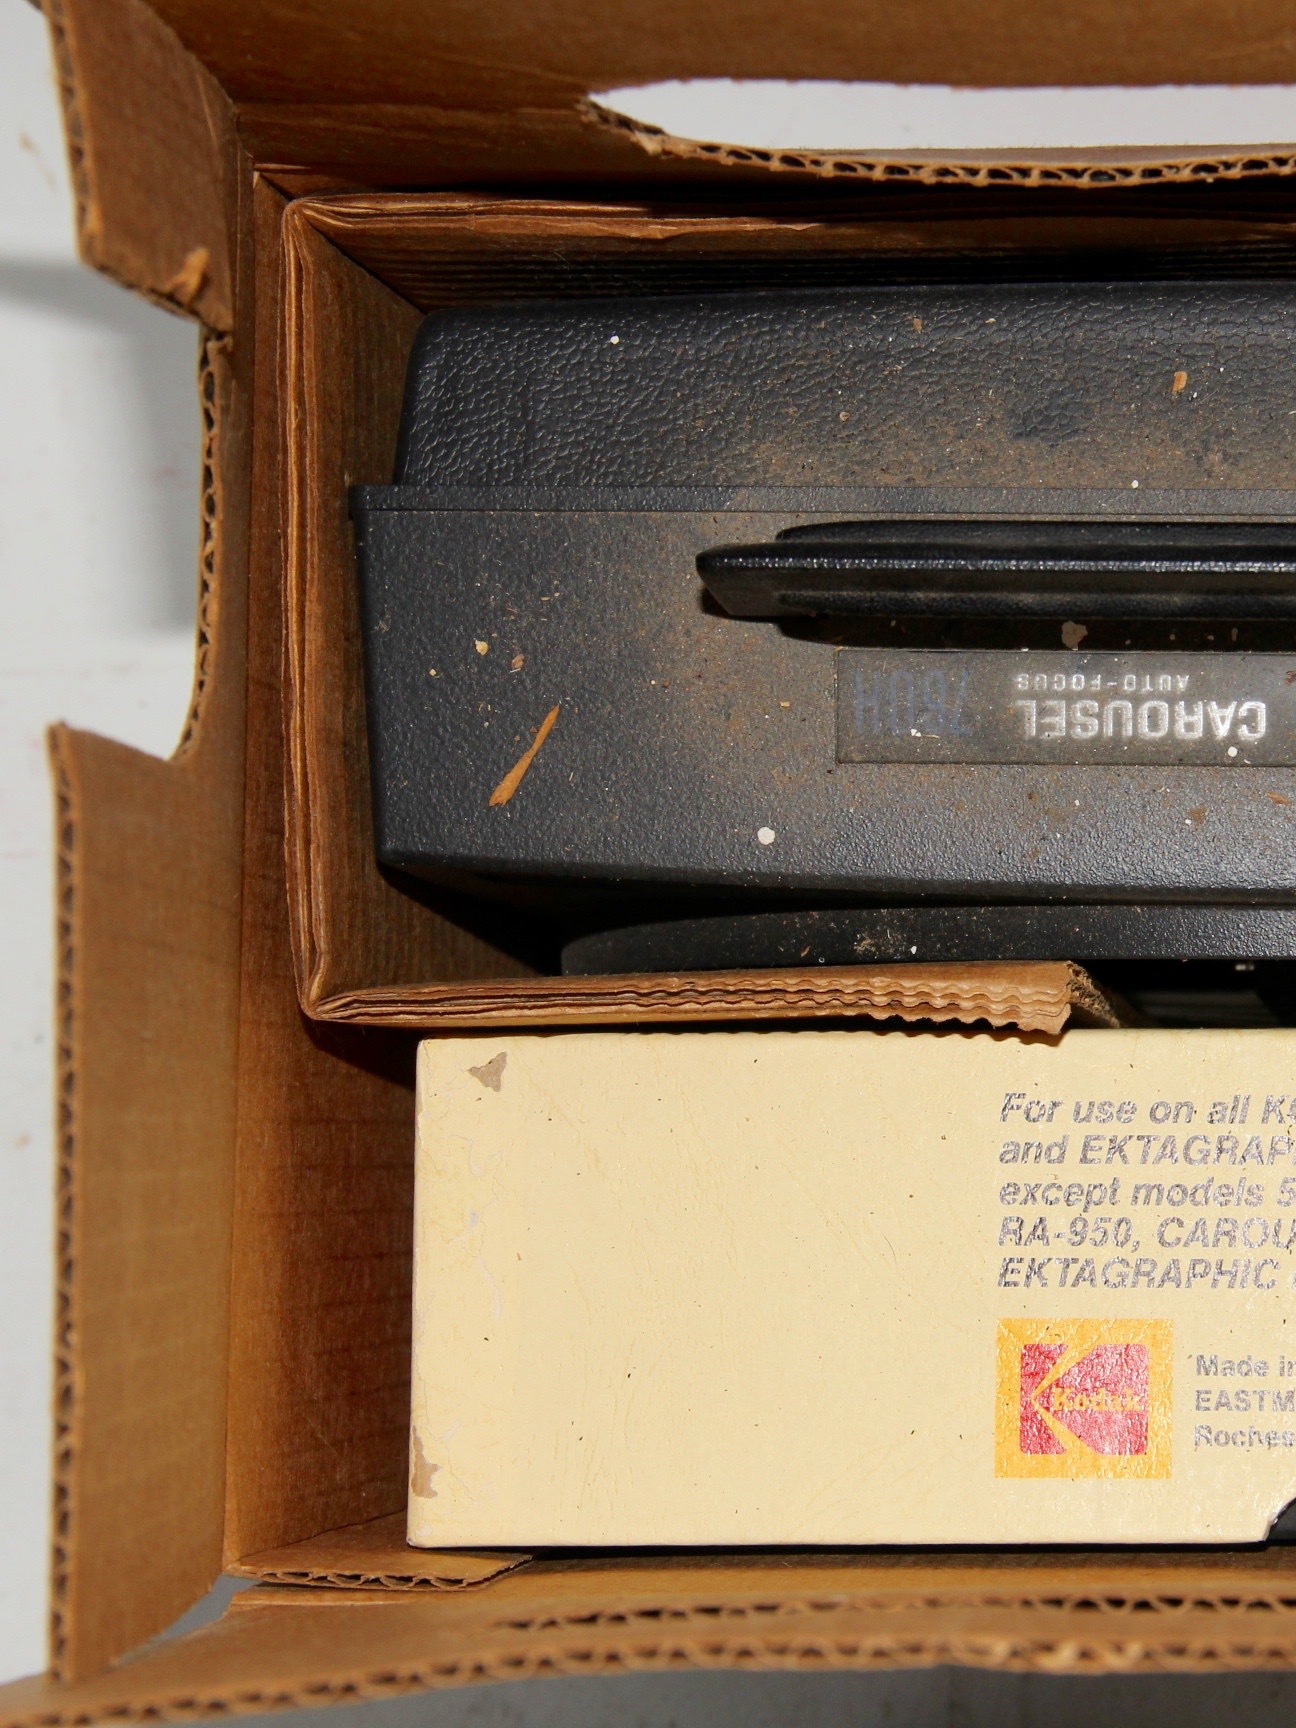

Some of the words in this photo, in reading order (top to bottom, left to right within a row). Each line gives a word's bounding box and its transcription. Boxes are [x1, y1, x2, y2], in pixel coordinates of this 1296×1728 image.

[1013, 700, 1267, 740] CAROUSEL
[1000, 1092, 1064, 1124] For
[1072, 1100, 1137, 1124] use
[1149, 1100, 1194, 1125] on
[1207, 1094, 1251, 1125] all
[998, 1134, 1069, 1165] and
[998, 1176, 1121, 1213] except
[1131, 1177, 1265, 1208] models
[998, 1216, 1141, 1253] RA-950,
[998, 1257, 1281, 1290] EKTAGRAPHIC
[1196, 1354, 1268, 1377] Made
[1053, 1386, 1143, 1411] Kodak
